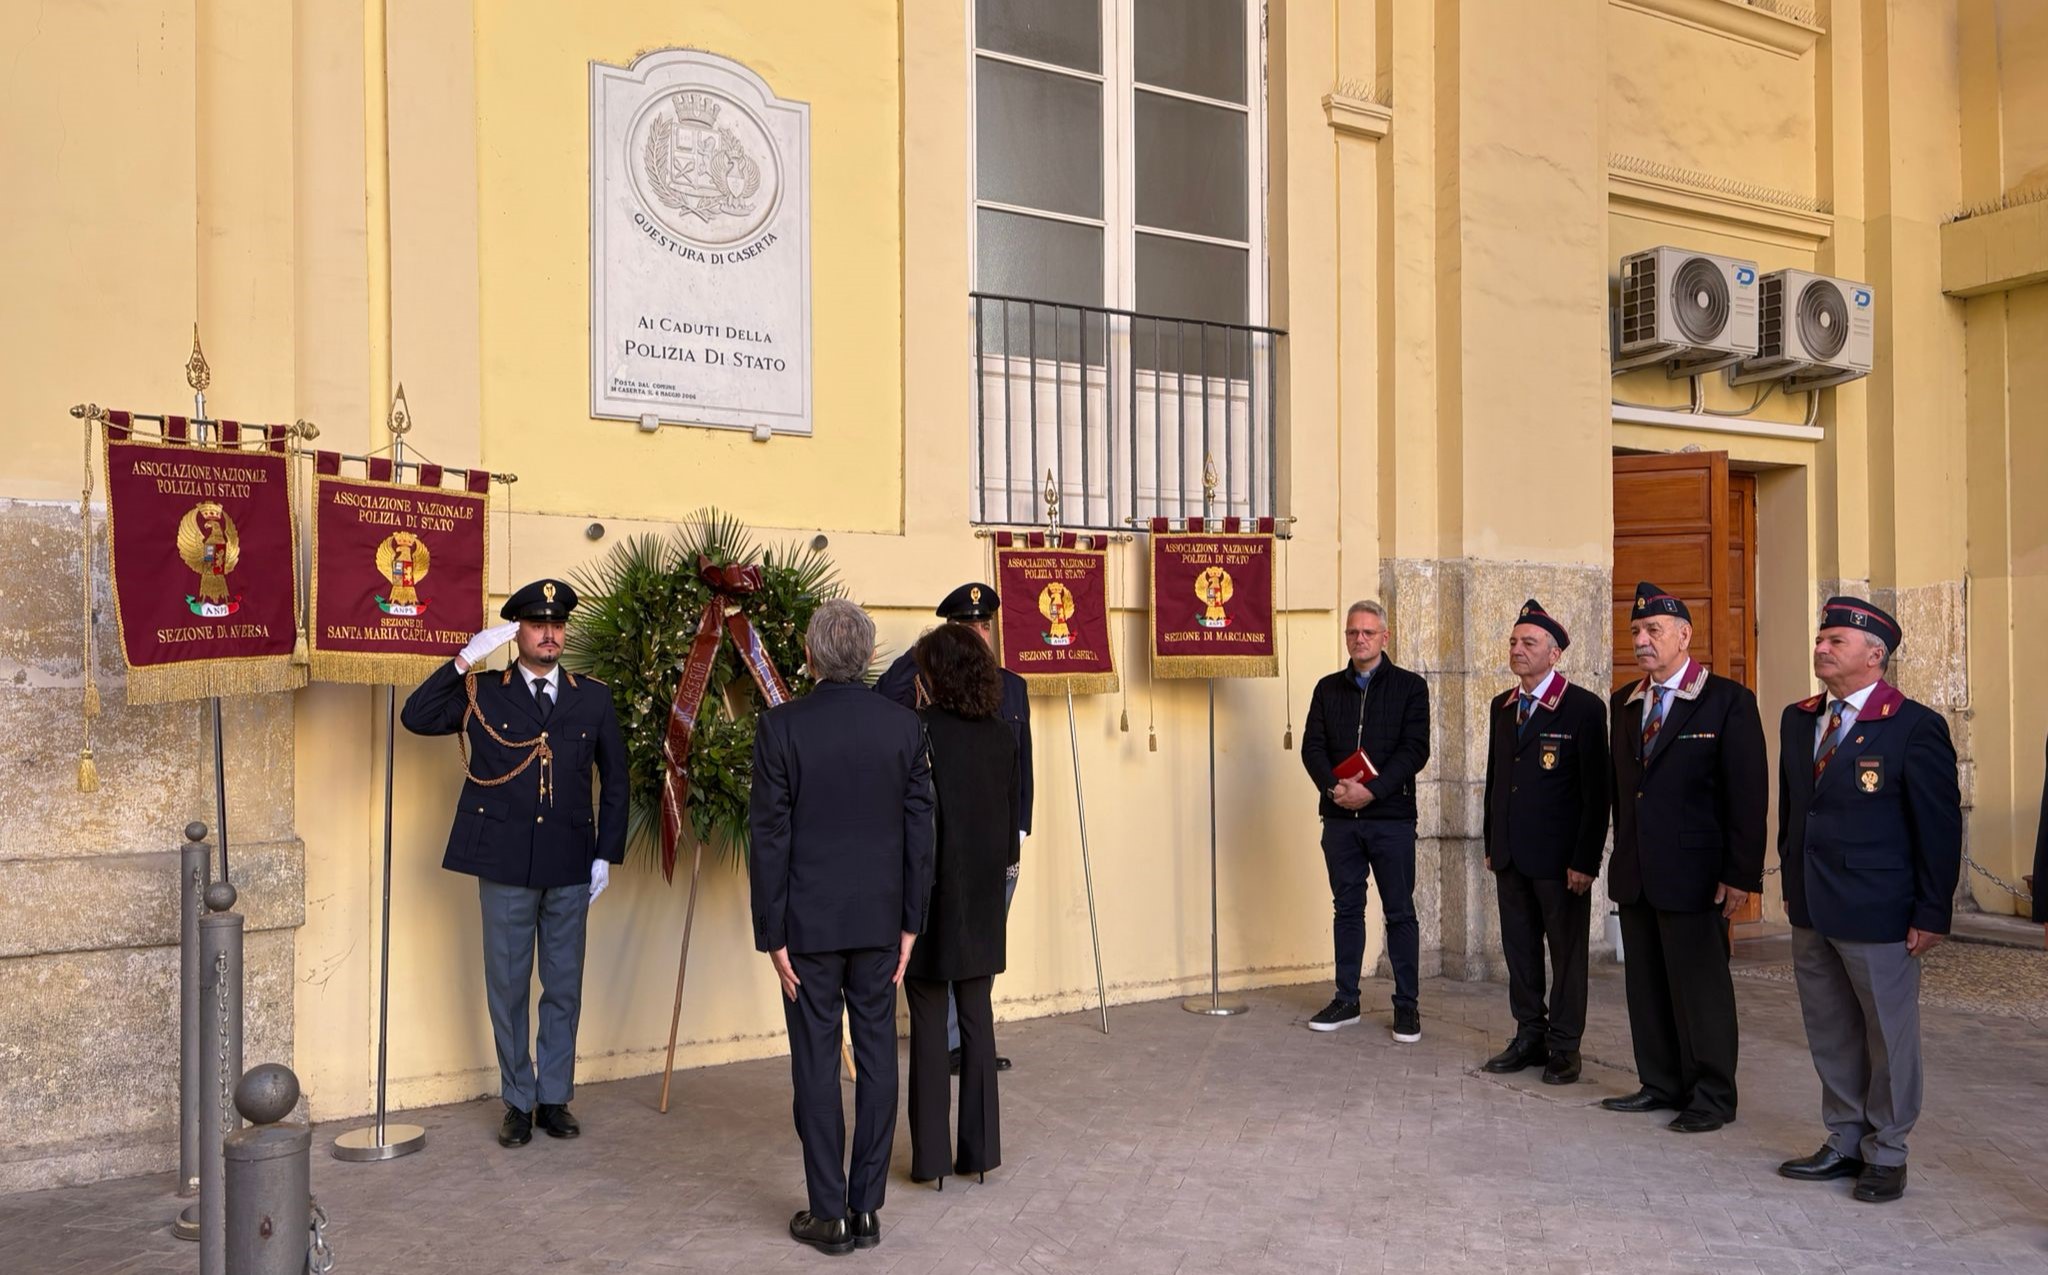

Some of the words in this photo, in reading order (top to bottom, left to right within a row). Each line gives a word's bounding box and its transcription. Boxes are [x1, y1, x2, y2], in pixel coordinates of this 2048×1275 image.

[634, 212, 706, 264] QUESTURA
[711, 253, 724, 265] DI
[727, 232, 778, 264] CASERTA
[659, 317, 720, 338] CADUTI
[625, 339, 696, 363] POLIZIA
[733, 351, 786, 372] STATO
[132, 460, 212, 481] ASSOCIAZIONE
[213, 466, 268, 484] NAZIONALE
[157, 479, 203, 497] POLIZIA
[204, 482, 217, 497] DI
[217, 483, 251, 499] STATO
[333, 490, 412, 513] ASSOCIAZIONE
[416, 501, 474, 520] NAZIONALE
[358, 509, 402, 526] POLIZIA
[406, 513, 418, 528] DI
[421, 516, 454, 532] STATO
[1164, 543, 1220, 554] ASSOCIAZIONE
[1222, 543, 1265, 555] NAZIONALE
[1182, 553, 1213, 564] POLIZIA
[1215, 554, 1224, 564] DI
[1226, 555, 1250, 565] STATO
[1007, 558, 1058, 569] ASSOCIAZIONE
[1060, 558, 1097, 569] NAZIONALE
[1024, 568, 1053, 580] POLIZIA
[1055, 569, 1063, 580] DI
[1064, 569, 1086, 580] STATO
[380, 617, 414, 628] SEZIONE
[415, 619, 424, 629] DI
[157, 625, 215, 644] SEZIONE
[217, 625, 229, 639] DI
[230, 624, 270, 639] AVERSA
[327, 625, 363, 640] SANTA
[364, 627, 400, 641] MARIA
[401, 628, 433, 643] CAPUA
[1164, 631, 1201, 643] SEZIONE
[1203, 631, 1213, 641] DI
[1216, 631, 1266, 643] MARCIANISE
[1018, 650, 1054, 662] SEZIONE
[1056, 649, 1066, 660] DI
[1068, 649, 1100, 661] CASERTA
[682, 661, 707, 706] CASERTA
